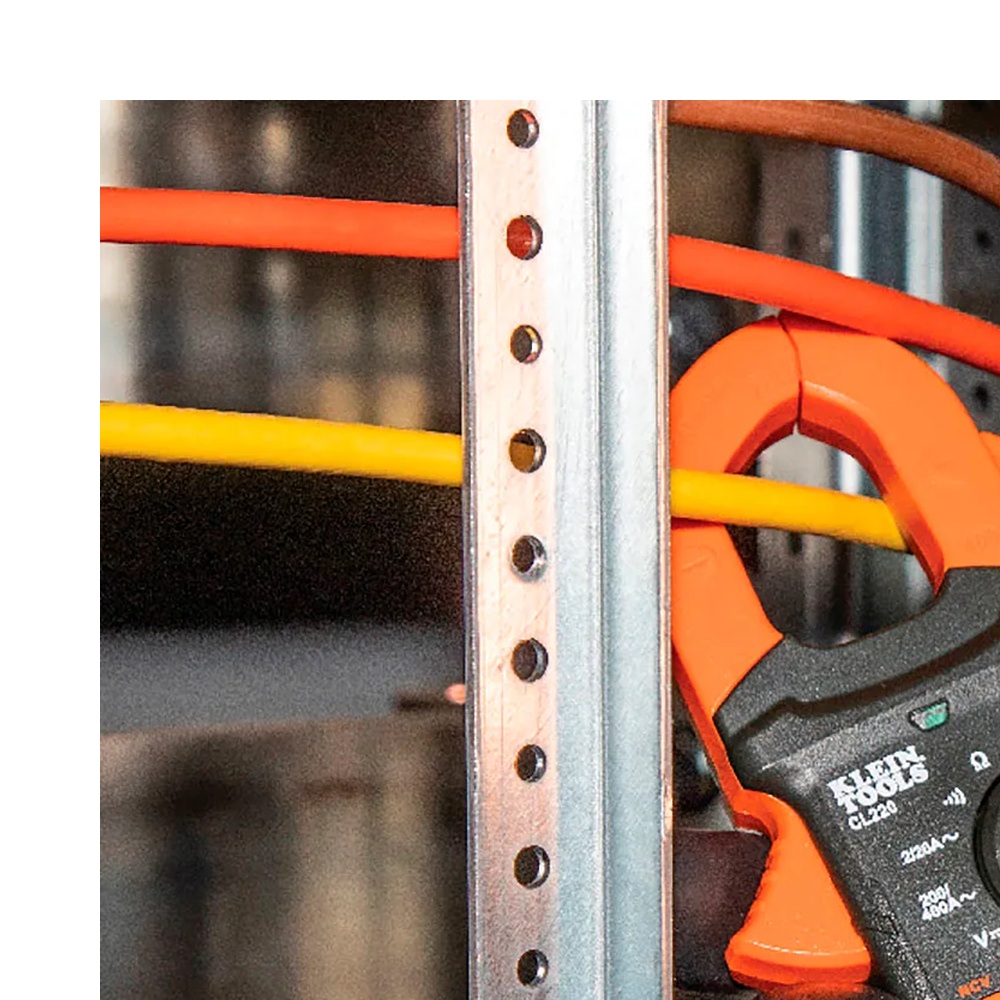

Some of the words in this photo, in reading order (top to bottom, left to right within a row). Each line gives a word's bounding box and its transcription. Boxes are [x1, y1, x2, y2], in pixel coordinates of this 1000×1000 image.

[826, 745, 926, 800] KLEIN
[837, 763, 929, 814] TOOLS
[848, 800, 898, 830] CL220
[957, 975, 991, 998] NCV
